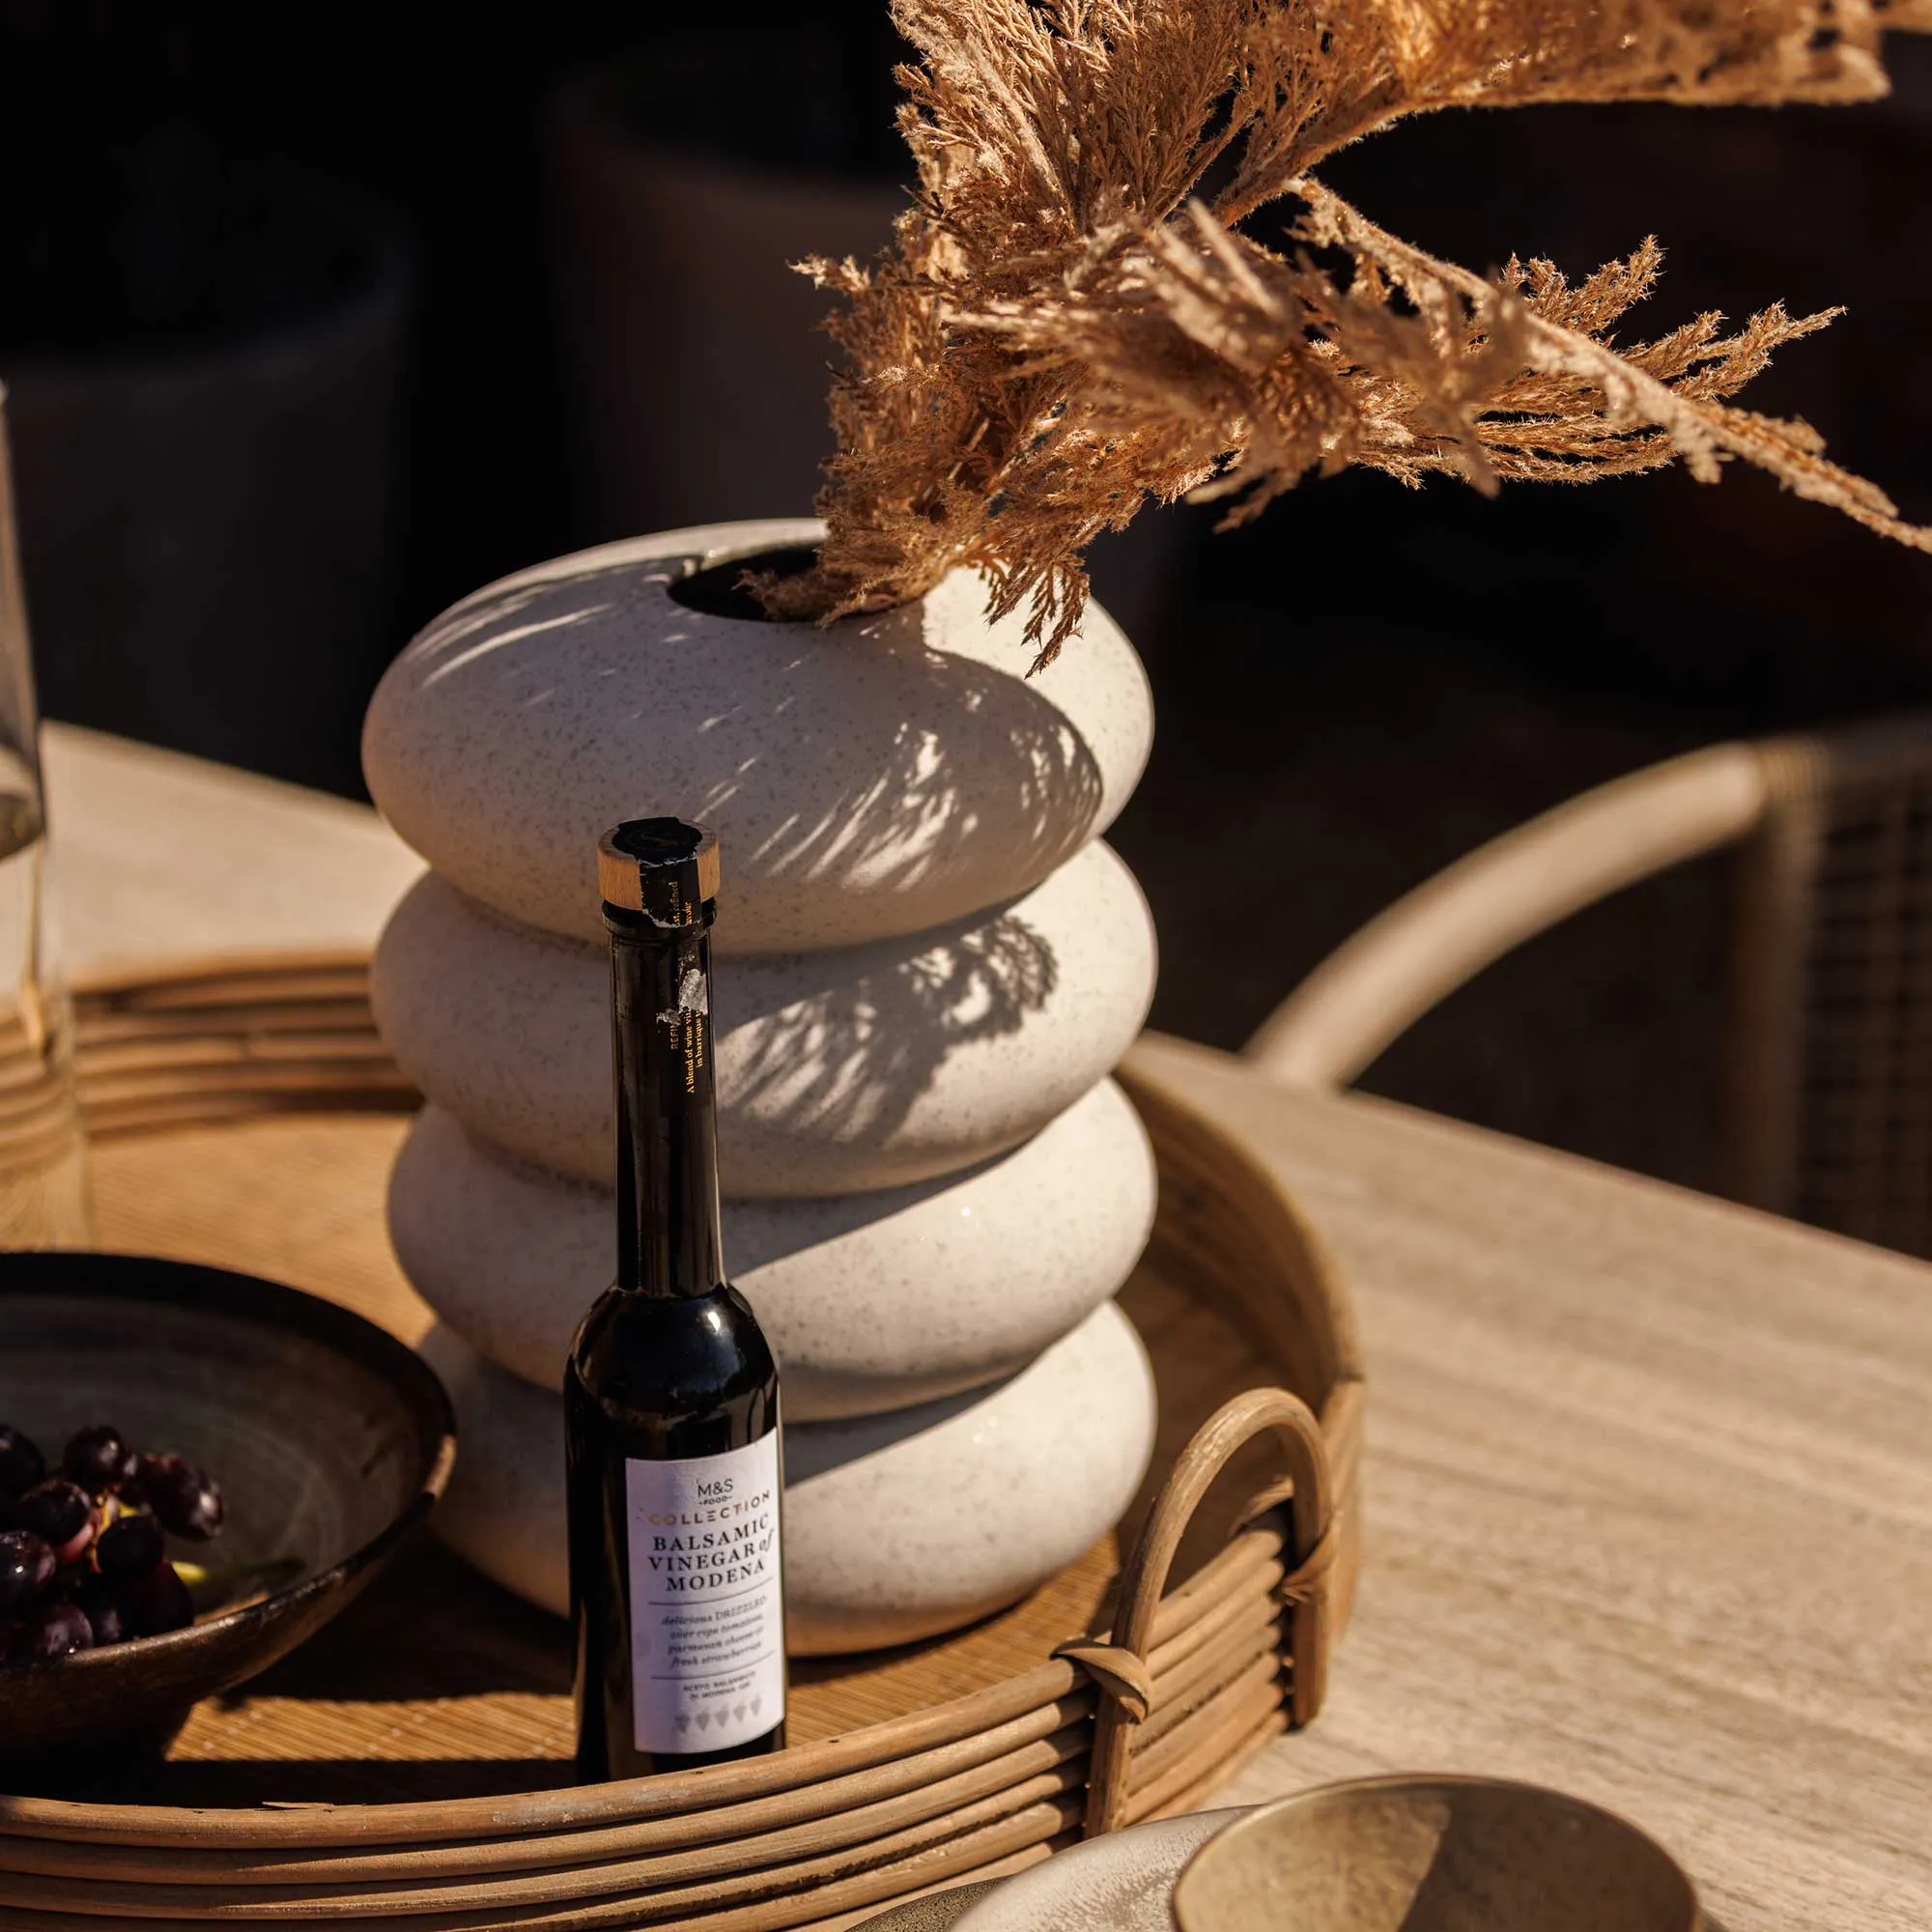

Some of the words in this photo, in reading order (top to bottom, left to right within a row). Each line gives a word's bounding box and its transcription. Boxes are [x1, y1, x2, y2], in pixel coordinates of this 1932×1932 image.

[668, 881, 679, 911] refined
[670, 1023, 679, 1049] REFIN
[684, 1026, 693, 1048] wine
[695, 1018, 703, 1057] barrique
[684, 1048, 694, 1058] of
[696, 1057, 703, 1067] in
[685, 1059, 695, 1085] blend
[687, 1085, 696, 1094] A
[697, 1478, 733, 1497] M&S
[648, 1489, 771, 1526] COLLECTION
[652, 1513, 769, 1551] BALSAMIC
[647, 1543, 755, 1572] VINEGAR
[759, 1527, 775, 1552] of
[665, 1558, 764, 1592] MODENA
